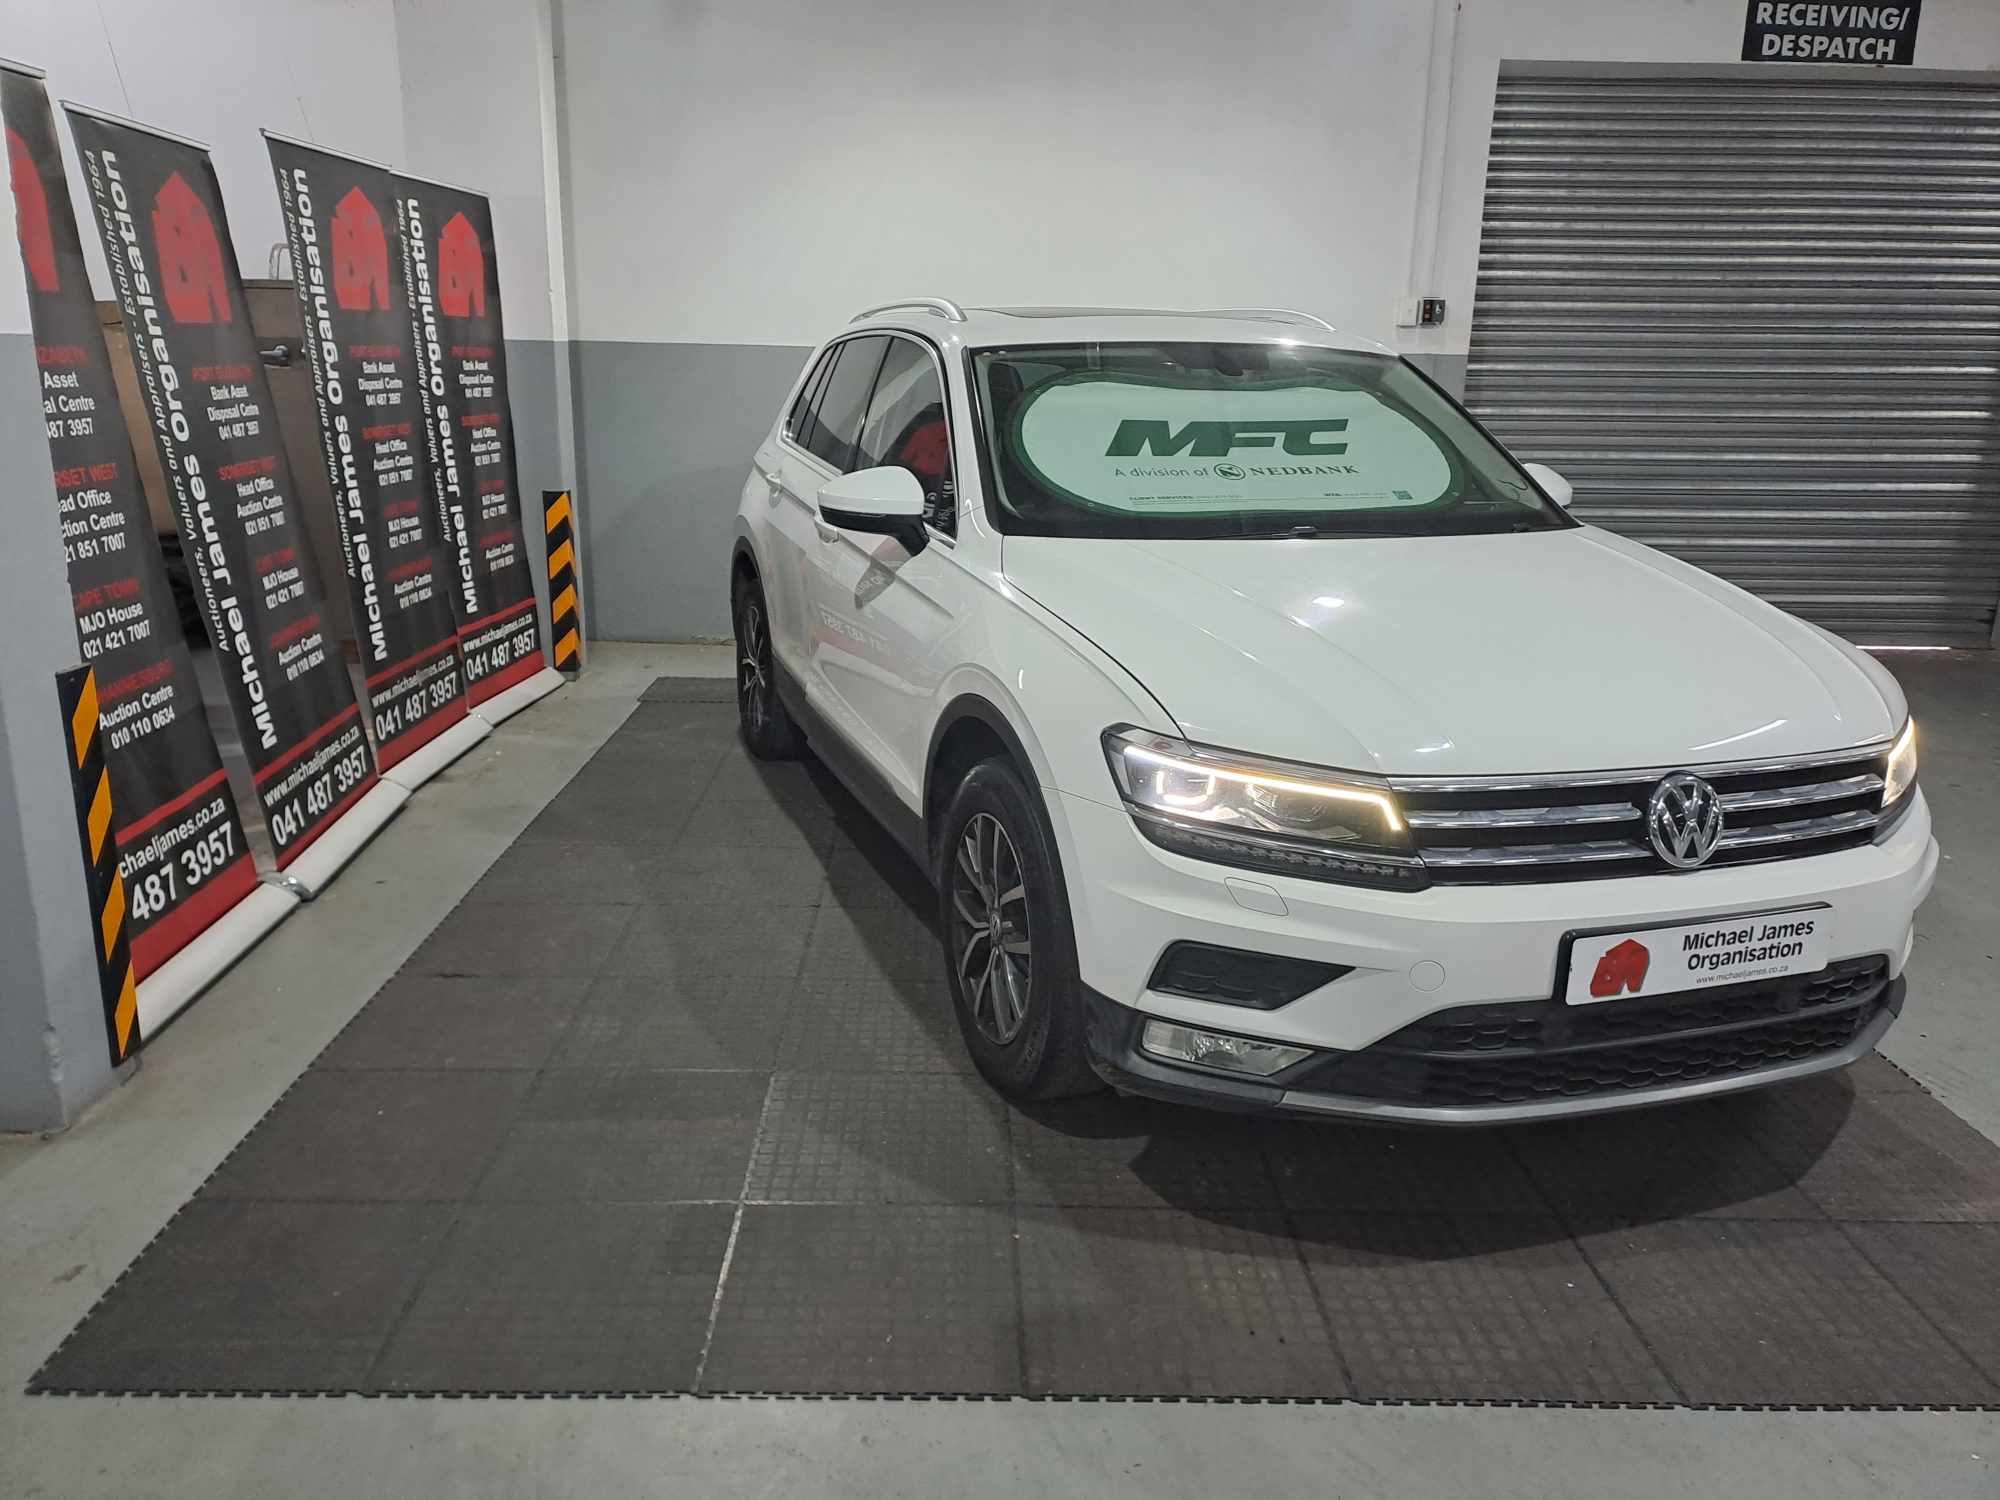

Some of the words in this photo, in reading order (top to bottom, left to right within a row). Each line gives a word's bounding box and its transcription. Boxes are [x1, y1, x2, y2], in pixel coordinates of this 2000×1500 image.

[1755, 2, 1911, 31] RECEIVING/
[1761, 33, 1896, 61] DESPATCH
[97, 203, 136, 316] Established
[102, 149, 190, 442] Organisation
[293, 168, 343, 406] Organisation
[407, 198, 445, 397] Organisation
[43, 371, 79, 389] Asset
[134, 333, 169, 431] Appraisers
[303, 316, 325, 396] Appraisers
[58, 395, 95, 412] Centre
[67, 417, 94, 436] 3957
[316, 397, 330, 427] and
[160, 434, 179, 471] and
[323, 431, 339, 485] Valuers
[436, 404, 461, 498] James
[1104, 418, 1349, 457] MFC
[335, 415, 365, 525] James
[1115, 467, 1127, 477] A
[1130, 466, 1190, 478] division
[1193, 467, 1209, 477] of
[1249, 464, 1361, 477] NEDBANK
[77, 489, 112, 509] Office
[90, 511, 126, 531] Centre
[173, 475, 198, 540] Valuers
[184, 454, 232, 586] James
[77, 538, 100, 559] 851
[101, 531, 126, 553] 7007
[450, 504, 479, 614] Michael
[79, 610, 106, 634] MJO
[106, 602, 144, 625] House
[194, 546, 231, 652] Auctioneers,
[352, 533, 388, 662] Michael
[83, 636, 104, 659] 021
[105, 629, 126, 650] 421
[127, 619, 151, 643] 7007
[466, 651, 489, 681] 041
[491, 640, 510, 668] 487
[512, 628, 536, 658] 3957
[220, 596, 278, 750] Michael
[371, 654, 455, 709] www.michaeljames.co.za
[98, 699, 141, 731] Auction
[142, 684, 174, 709] Centre
[111, 728, 131, 749] 010
[131, 716, 151, 739] 110
[152, 704, 176, 730] 0634
[375, 705, 402, 740] 041
[405, 690, 427, 723] 487
[429, 671, 458, 707] 3957
[264, 725, 360, 807] www.michaeljames.co.za
[271, 797, 305, 846] 041
[307, 772, 334, 816] 487
[333, 745, 368, 793] 3957
[131, 861, 177, 921] 487
[181, 820, 234, 886] 3957
[1682, 928, 1756, 952] Michael
[1756, 919, 1815, 942] James
[1687, 938, 1804, 971] Organisation
[1695, 964, 1789, 984] www.michaeljames.co.za
